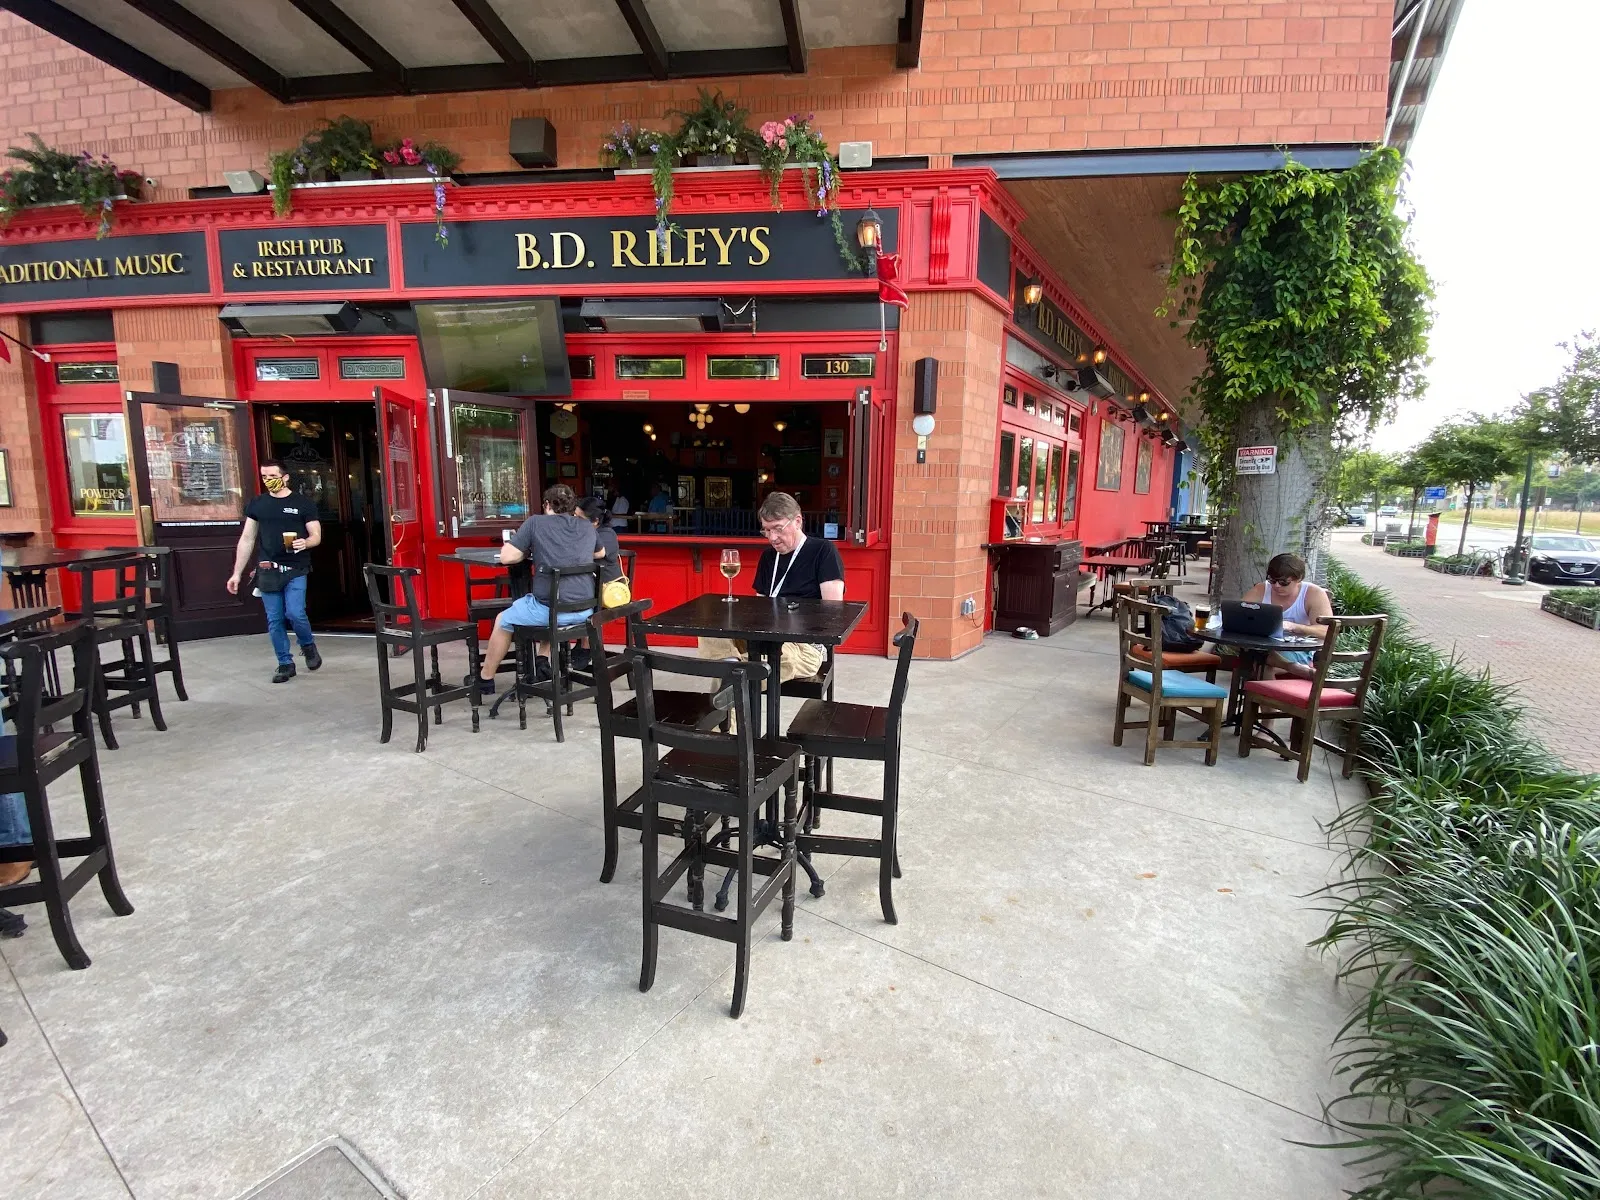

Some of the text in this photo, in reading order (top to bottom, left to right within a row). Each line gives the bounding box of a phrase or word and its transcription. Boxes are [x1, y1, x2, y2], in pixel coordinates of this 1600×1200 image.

[258, 238, 343, 257] IRISH PUB
[515, 226, 771, 270] B.D. RILEY'S
[114, 253, 184, 276] MUSIC
[232, 258, 374, 278] & RESTAURANT
[825, 361, 850, 374] 130
[80, 488, 125, 499] POWER'S
